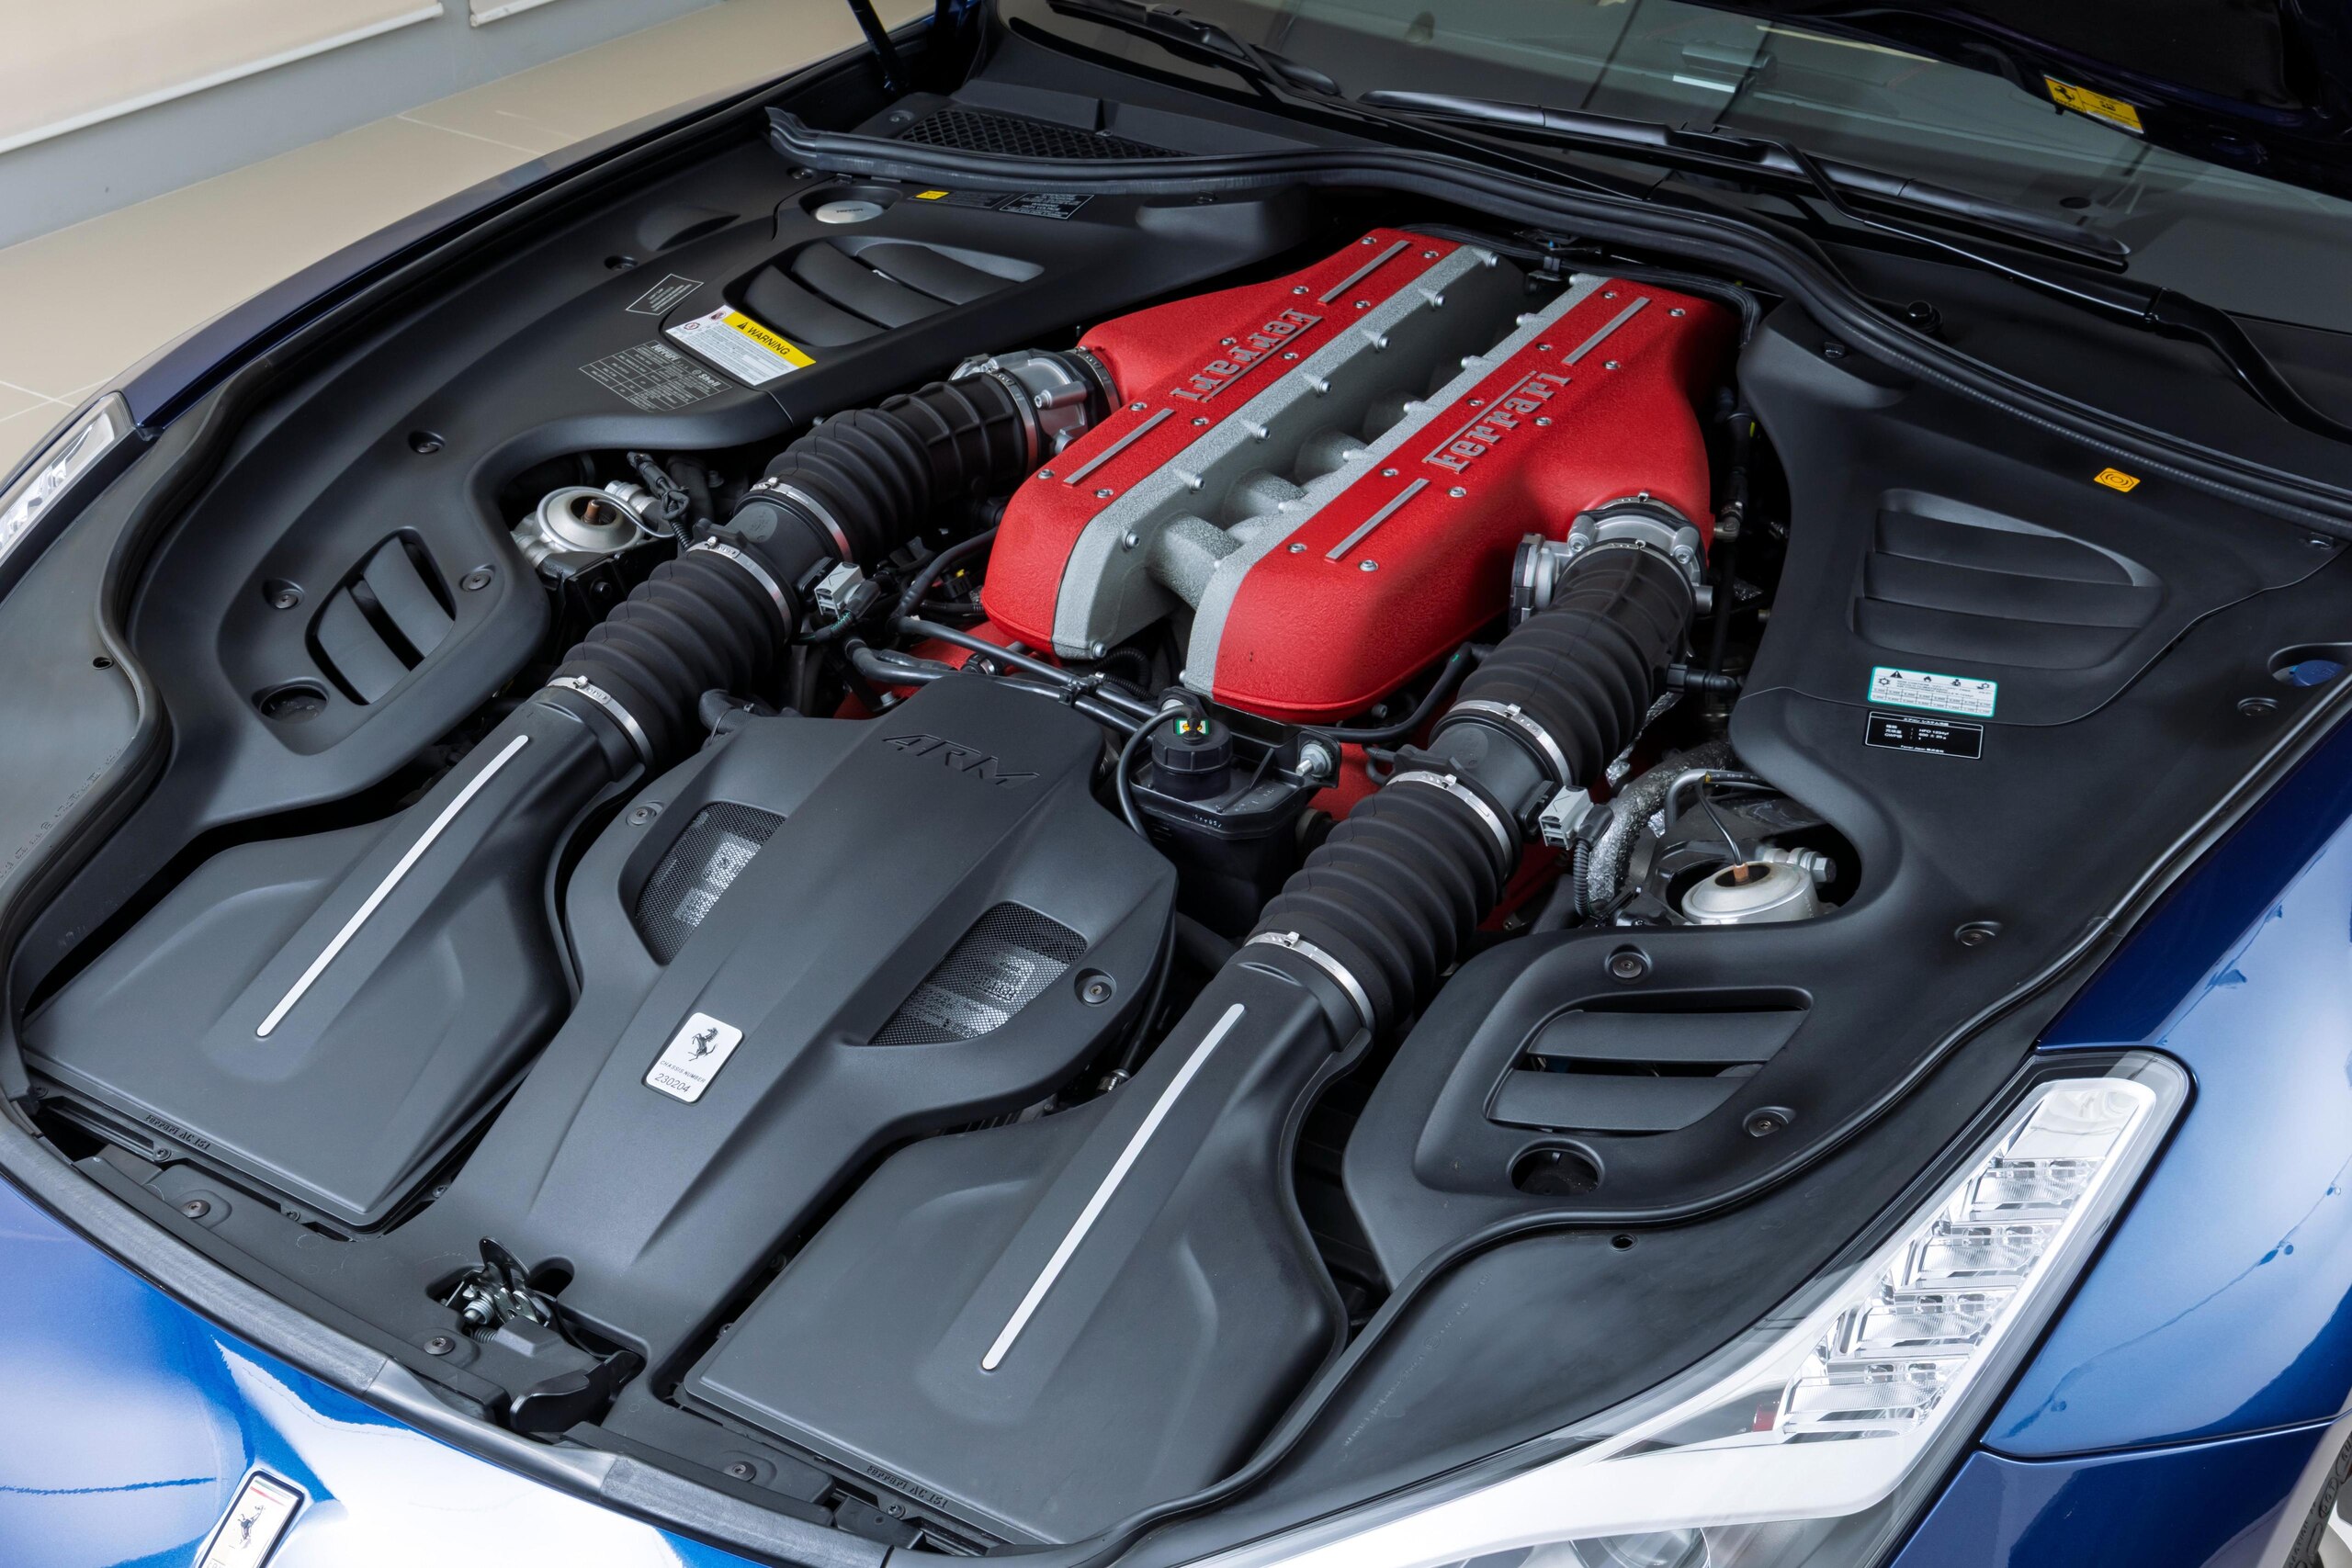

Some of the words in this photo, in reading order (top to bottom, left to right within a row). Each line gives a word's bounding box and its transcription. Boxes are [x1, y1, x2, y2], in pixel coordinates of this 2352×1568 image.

[748, 326, 790, 355] WARNING
[1170, 308, 1322, 402] Ferrari
[698, 373, 721, 387] Shell
[1422, 369, 1572, 472] Ferrari
[654, 1072, 691, 1093] 230204
[660, 1060, 684, 1074] CHASSIS
[684, 1070, 706, 1083] NUMBER
[144, 1114, 180, 1135] Ferrari
[179, 1131, 195, 1142] AC
[193, 1138, 211, 1150] 151
[865, 1465, 909, 1490] Ferrari
[909, 1485, 928, 1498] AC
[926, 1494, 949, 1508] 151
